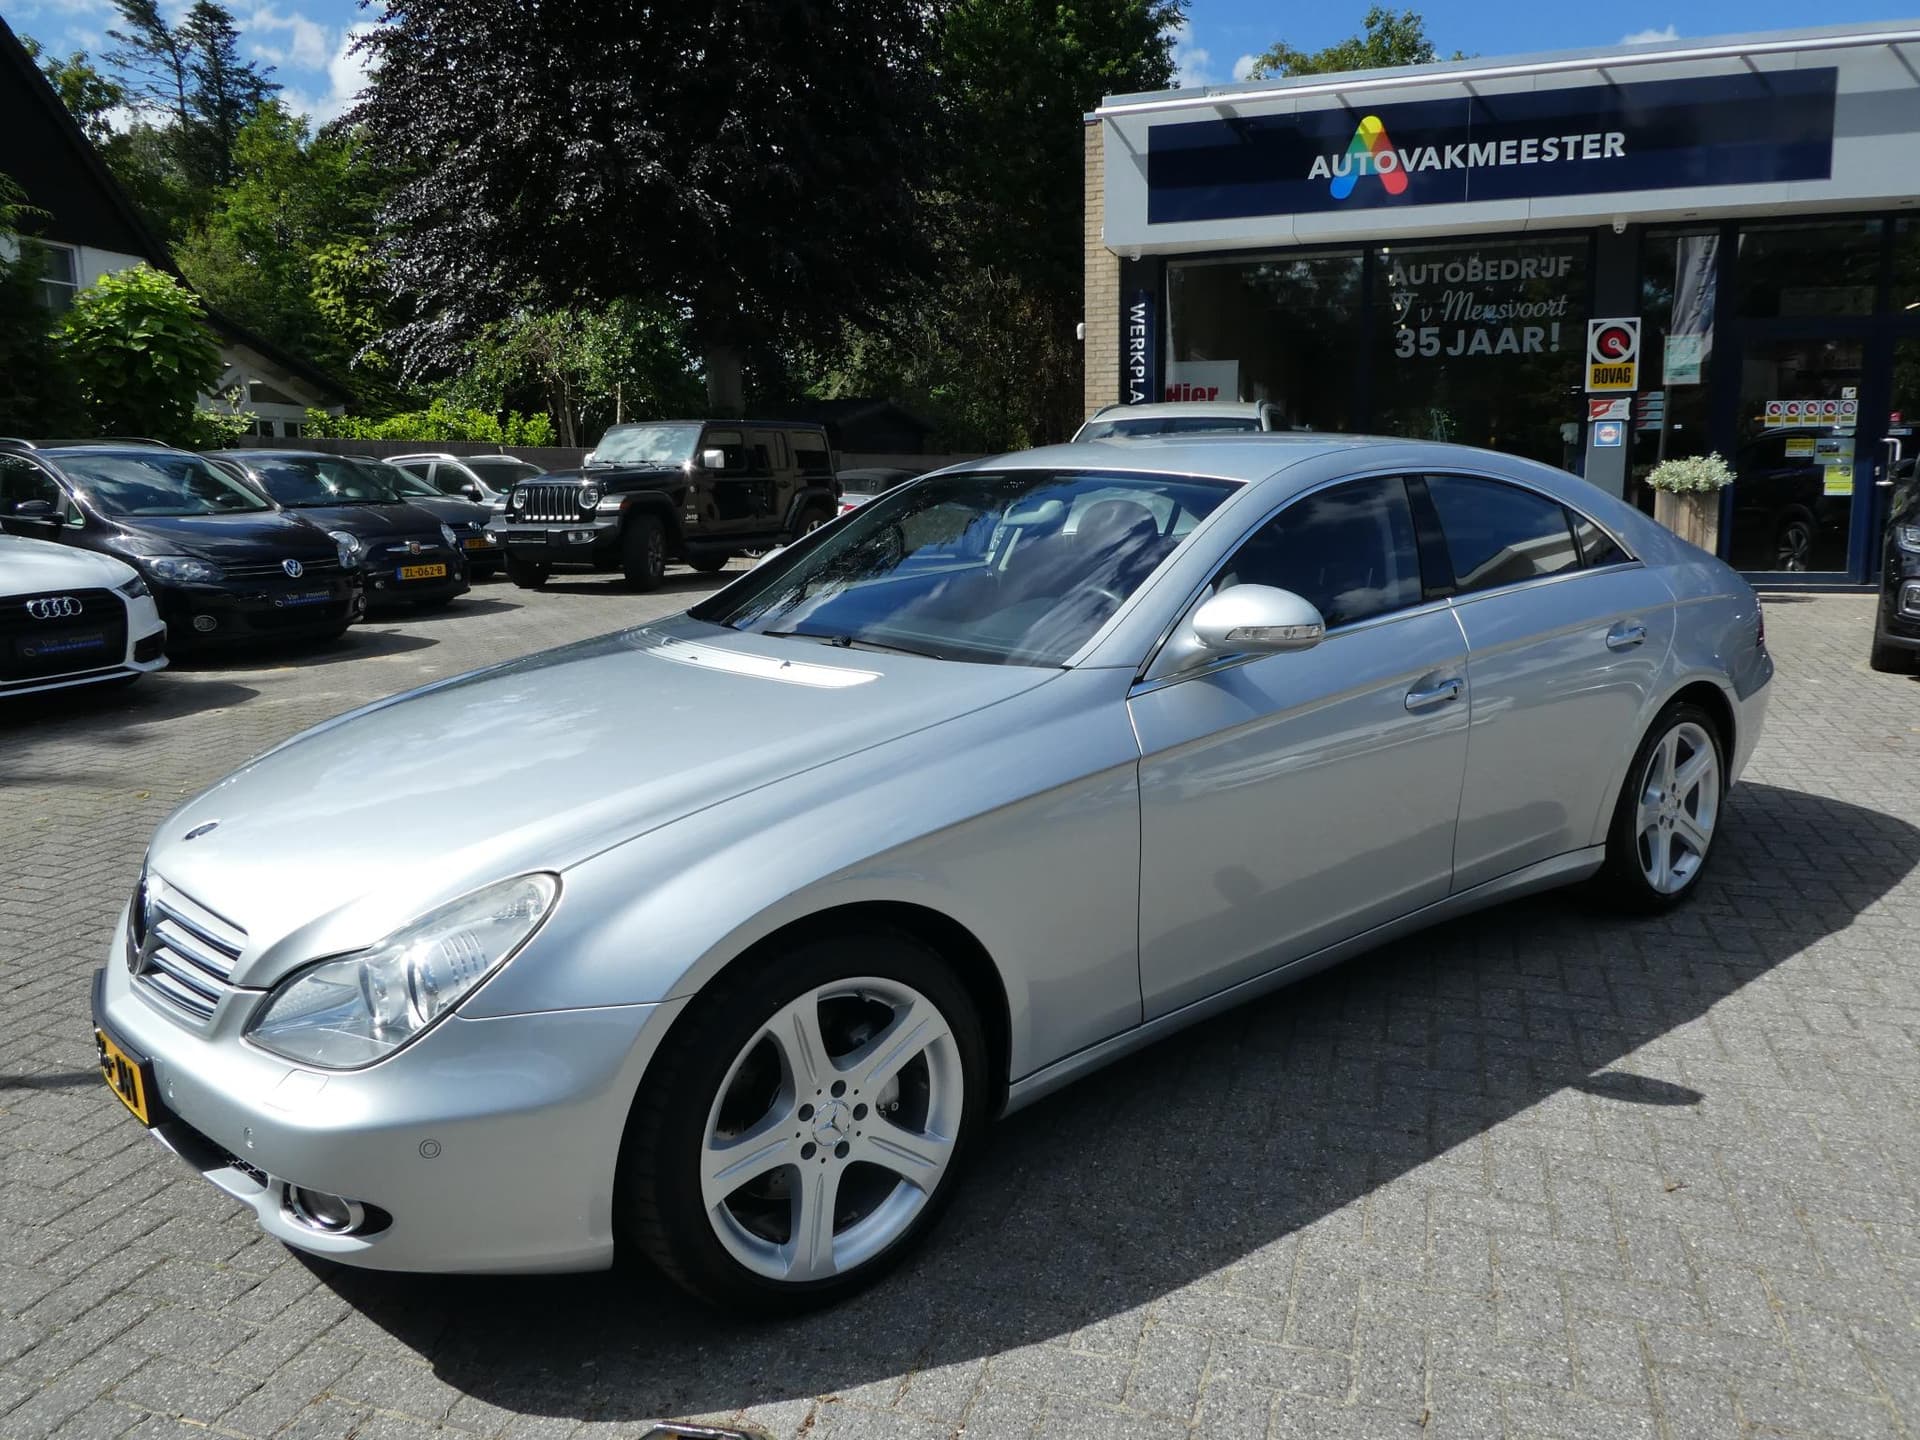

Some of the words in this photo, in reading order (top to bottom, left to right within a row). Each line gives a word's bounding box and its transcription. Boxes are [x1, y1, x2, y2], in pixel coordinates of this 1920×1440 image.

[1307, 132, 1626, 180] AUTOVAKMEESTER
[1393, 255, 1573, 286] AUTOBEDRIJF
[1394, 326, 1441, 358] 35
[1446, 322, 1560, 356] JAAR!
[1593, 366, 1632, 385] BOVAG
[1166, 383, 1219, 402] Hier
